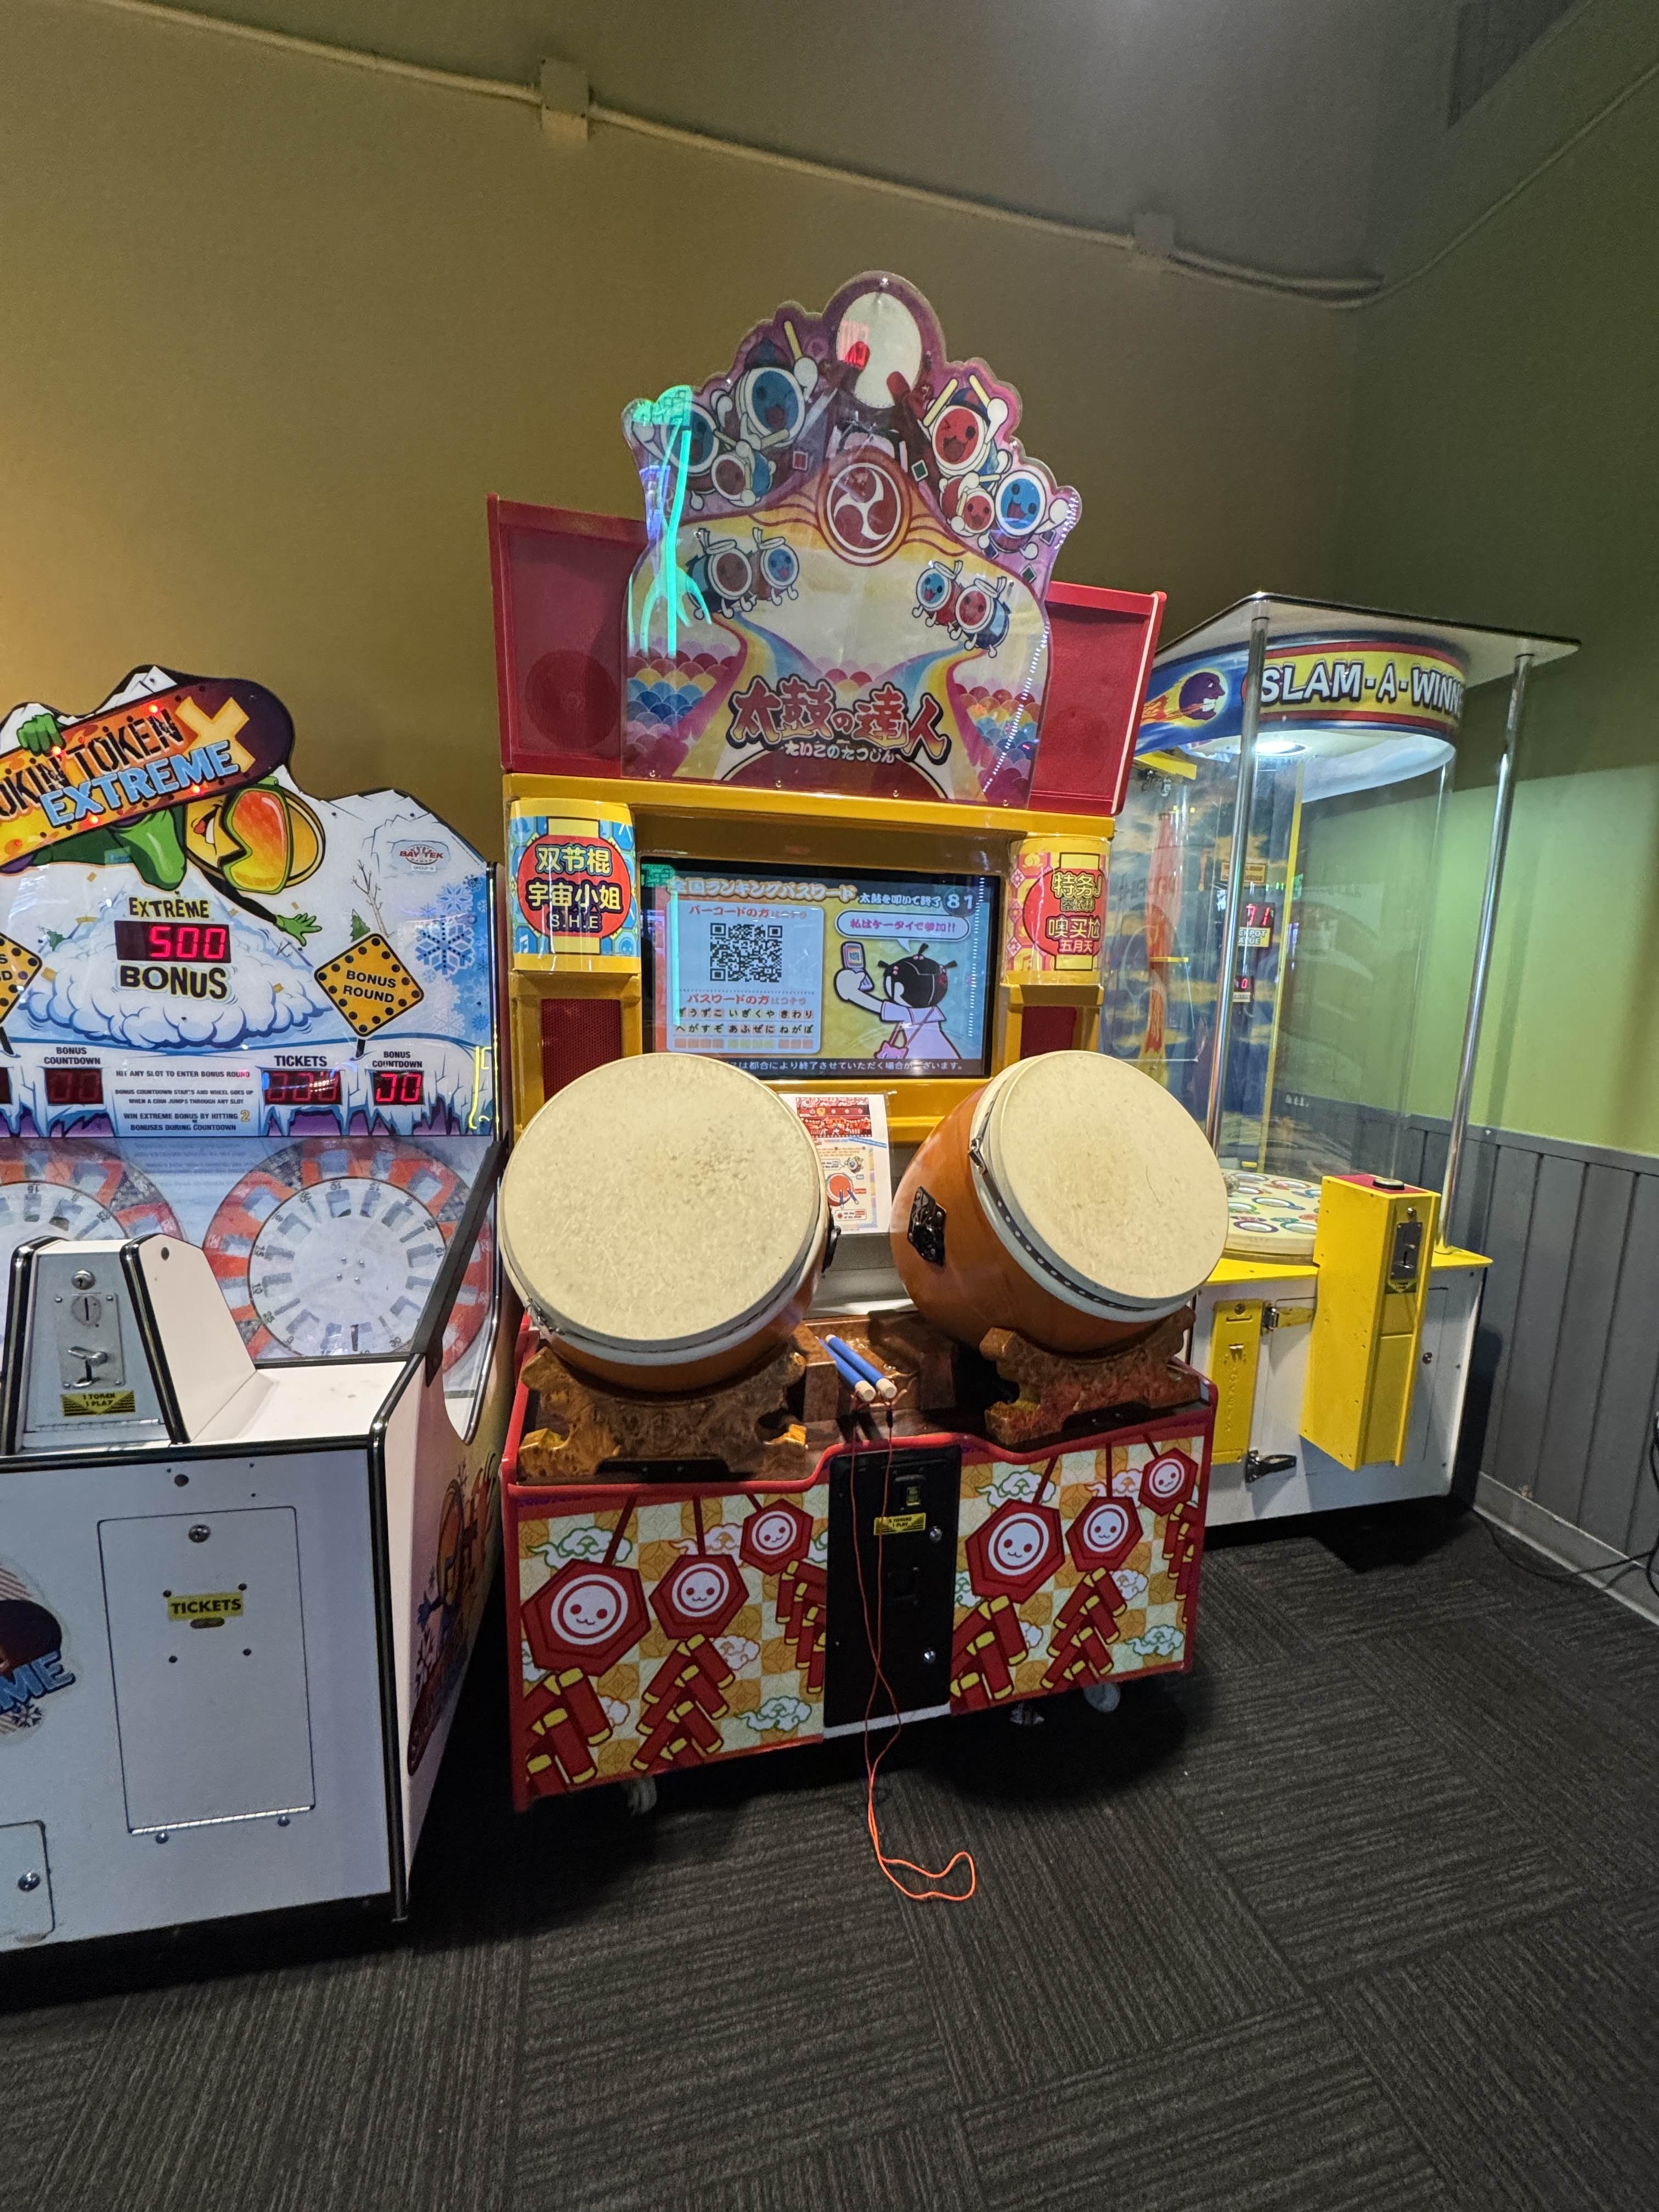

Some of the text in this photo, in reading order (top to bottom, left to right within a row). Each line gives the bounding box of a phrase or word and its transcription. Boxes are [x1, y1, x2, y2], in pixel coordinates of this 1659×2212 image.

[731, 676, 947, 760] 太鼓の達人
[67, 709, 184, 781] TOKEN
[785, 741, 896, 763] たいこのたつじん
[41, 740, 238, 826] EXTREME
[537, 847, 612, 874] 双节棍
[528, 882, 621, 910] 宇宙小姐
[947, 894, 973, 910] 81
[129, 897, 210, 918] EXTREME
[551, 914, 599, 929] S.H.E
[150, 927, 226, 958] 500
[1060, 940, 1093, 953] 五月天
[120, 965, 227, 999] BONUS
[346, 970, 396, 988] BONUS
[343, 985, 394, 1003] ROUND
[274, 1055, 327, 1066] TICKETS
[240, 1110, 250, 1122] 2
[171, 1598, 242, 1614] TICKETS
